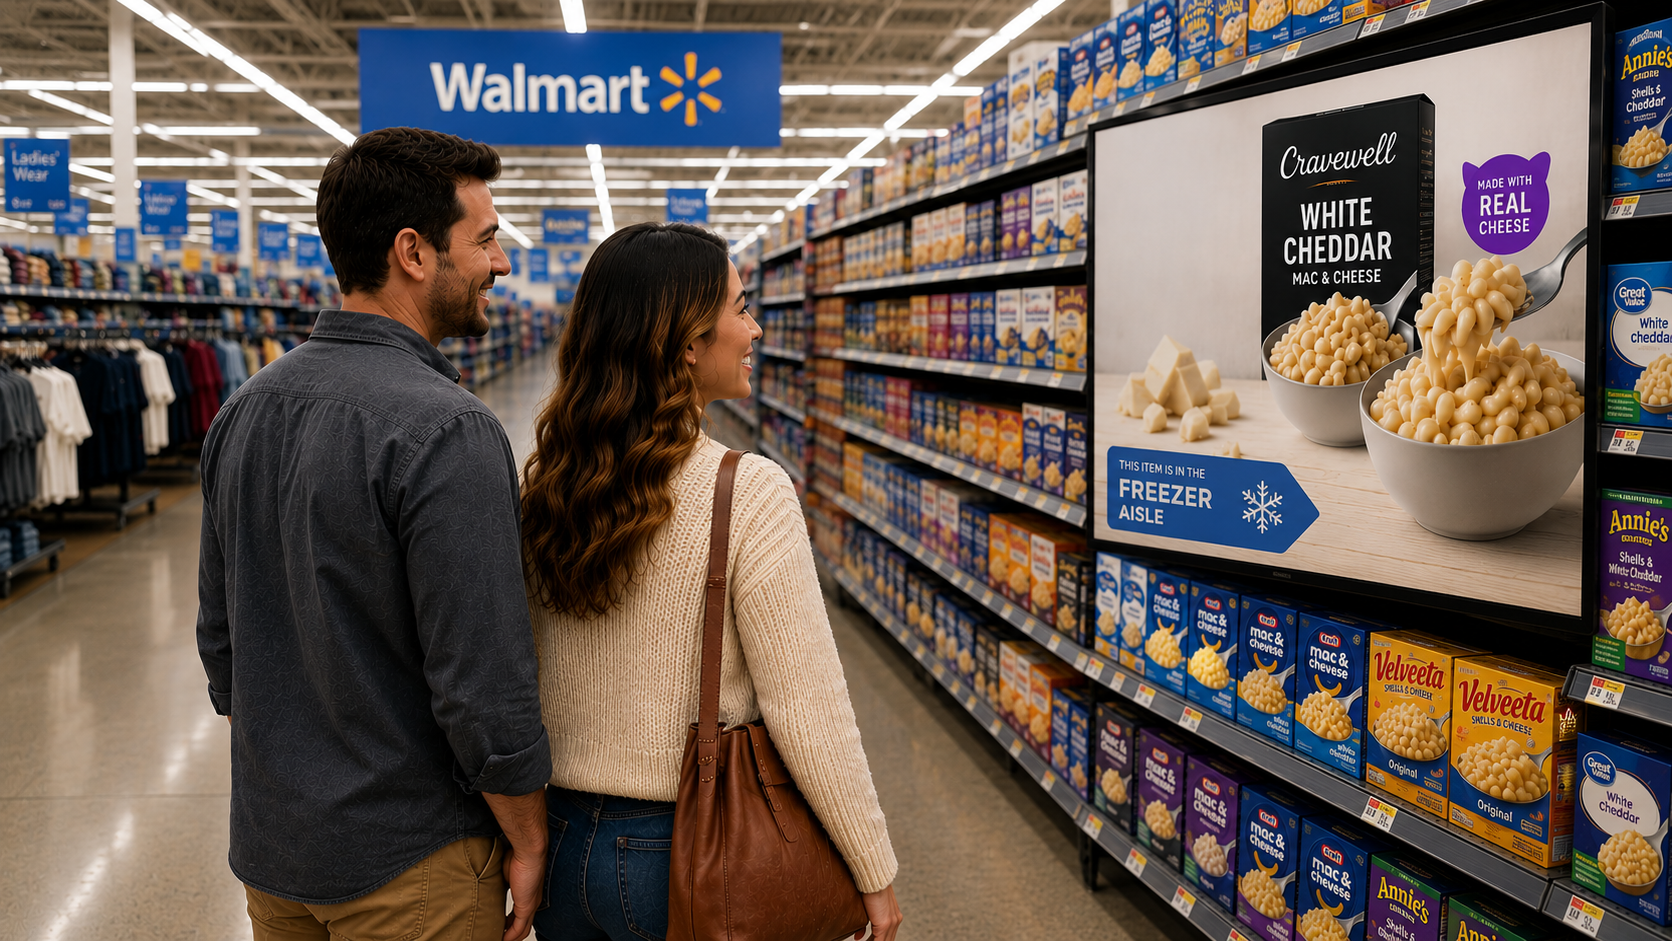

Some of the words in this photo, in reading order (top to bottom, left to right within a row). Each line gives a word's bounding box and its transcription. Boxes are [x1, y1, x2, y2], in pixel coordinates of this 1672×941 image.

[429, 62, 650, 114] Walmart
[1280, 131, 1398, 180] Cravewell
[13, 167, 49, 182] Wear
[1477, 177, 1504, 190] MADE
[1507, 174, 1533, 187] WITH
[1300, 196, 1373, 231] WHITE
[1480, 191, 1532, 216] REAL
[1479, 217, 1530, 235] CHEESE
[1283, 231, 1393, 265] CHEDDAR
[1292, 271, 1319, 285] MAC
[1321, 271, 1331, 284] &
[1333, 268, 1382, 284] CHEESE
[1619, 286, 1646, 299] Great
[1639, 317, 1669, 329] White
[1119, 459, 1140, 472] THIS
[1141, 461, 1163, 474] ITEM
[1165, 464, 1173, 475] IS
[1175, 466, 1185, 477] IN
[1187, 467, 1205, 479] THE
[1119, 478, 1213, 509] FREEZER
[1118, 504, 1164, 525] AISLE
[1608, 509, 1670, 543] Annie's
[1619, 551, 1645, 567] Shells
[1198, 609, 1218, 625] mac
[1218, 614, 1228, 628] &
[1250, 626, 1274, 642] mac
[1274, 631, 1284, 648] &
[1310, 646, 1337, 663] mac
[1338, 652, 1349, 669] &
[1374, 650, 1445, 690] Velveeta
[1458, 678, 1546, 723] Velveeta
[1388, 759, 1418, 779] Original
[1587, 756, 1611, 774] Great
[1194, 787, 1217, 811] mac
[1217, 800, 1228, 818] &
[1477, 799, 1513, 823] Original
[1250, 821, 1275, 844] mac
[1275, 833, 1285, 851] &
[1312, 856, 1340, 882] mac
[1340, 871, 1352, 890] &
[1377, 876, 1430, 925] Annie's
